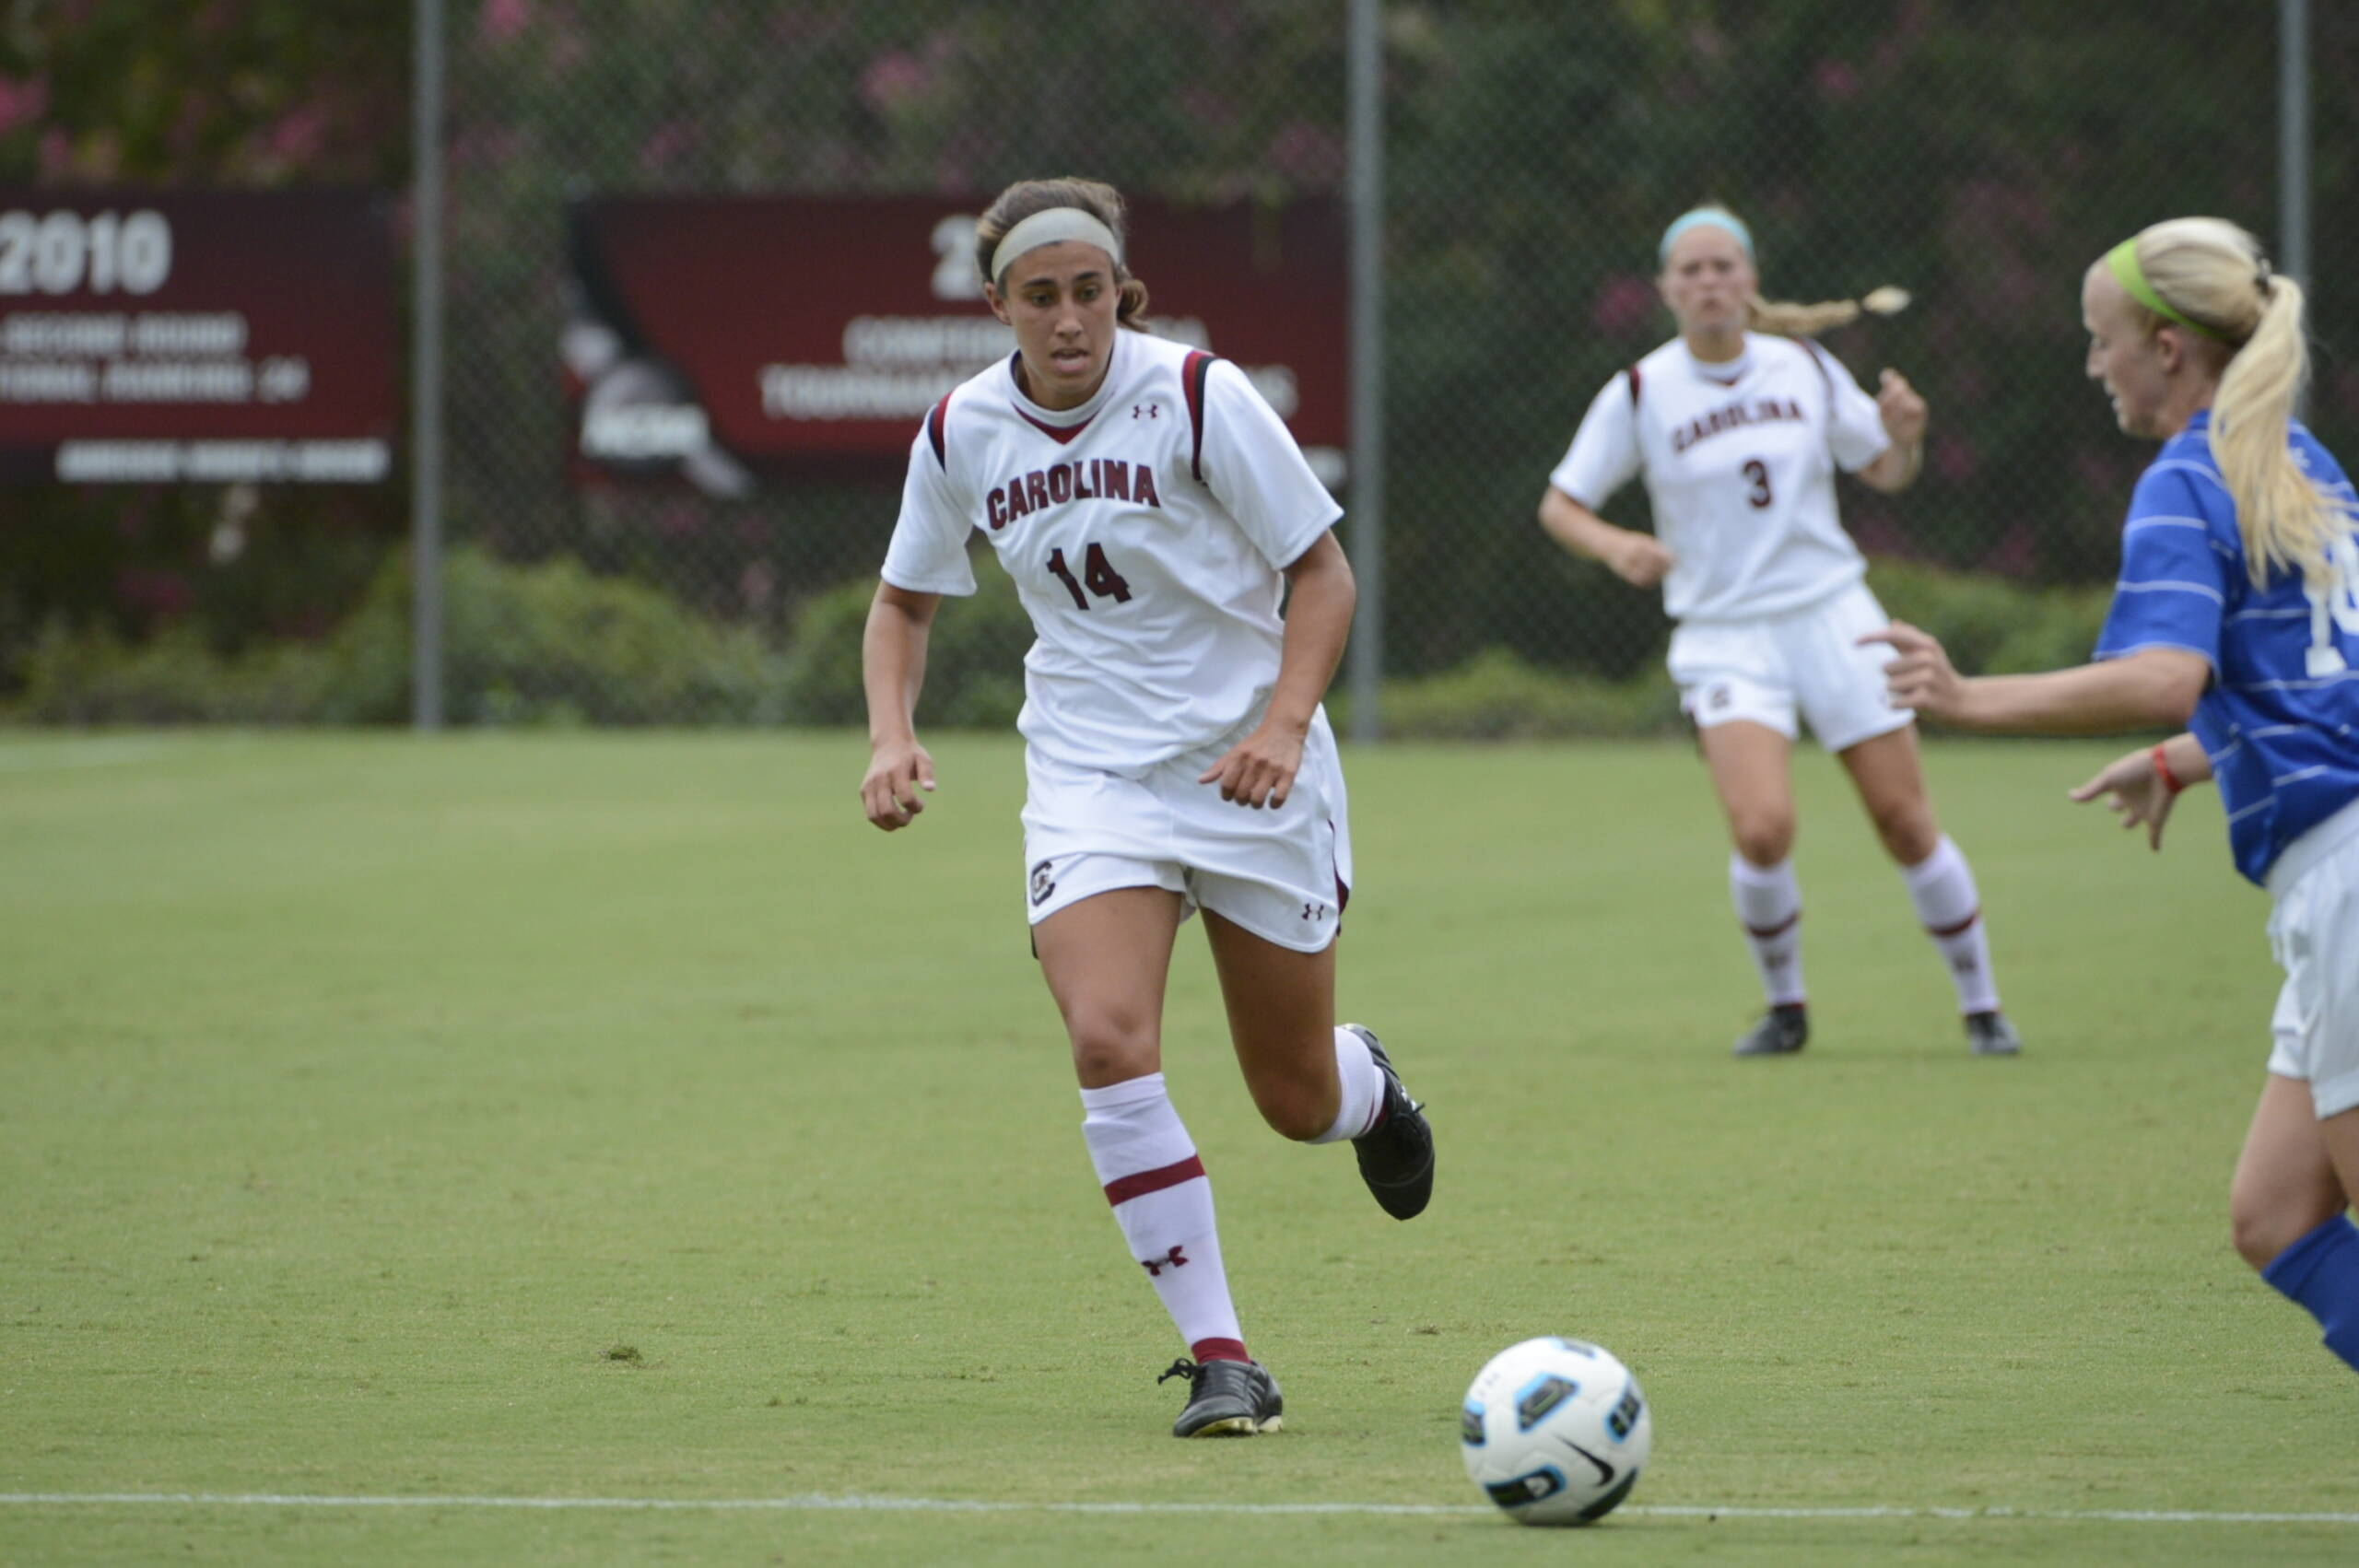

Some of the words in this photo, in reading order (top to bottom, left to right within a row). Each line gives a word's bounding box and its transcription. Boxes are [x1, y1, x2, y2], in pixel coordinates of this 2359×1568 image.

[0, 211, 170, 293] 2010
[986, 458, 1161, 531] CAROLINA
[1743, 460, 1772, 508] 3
[1046, 542, 1133, 610] 14
